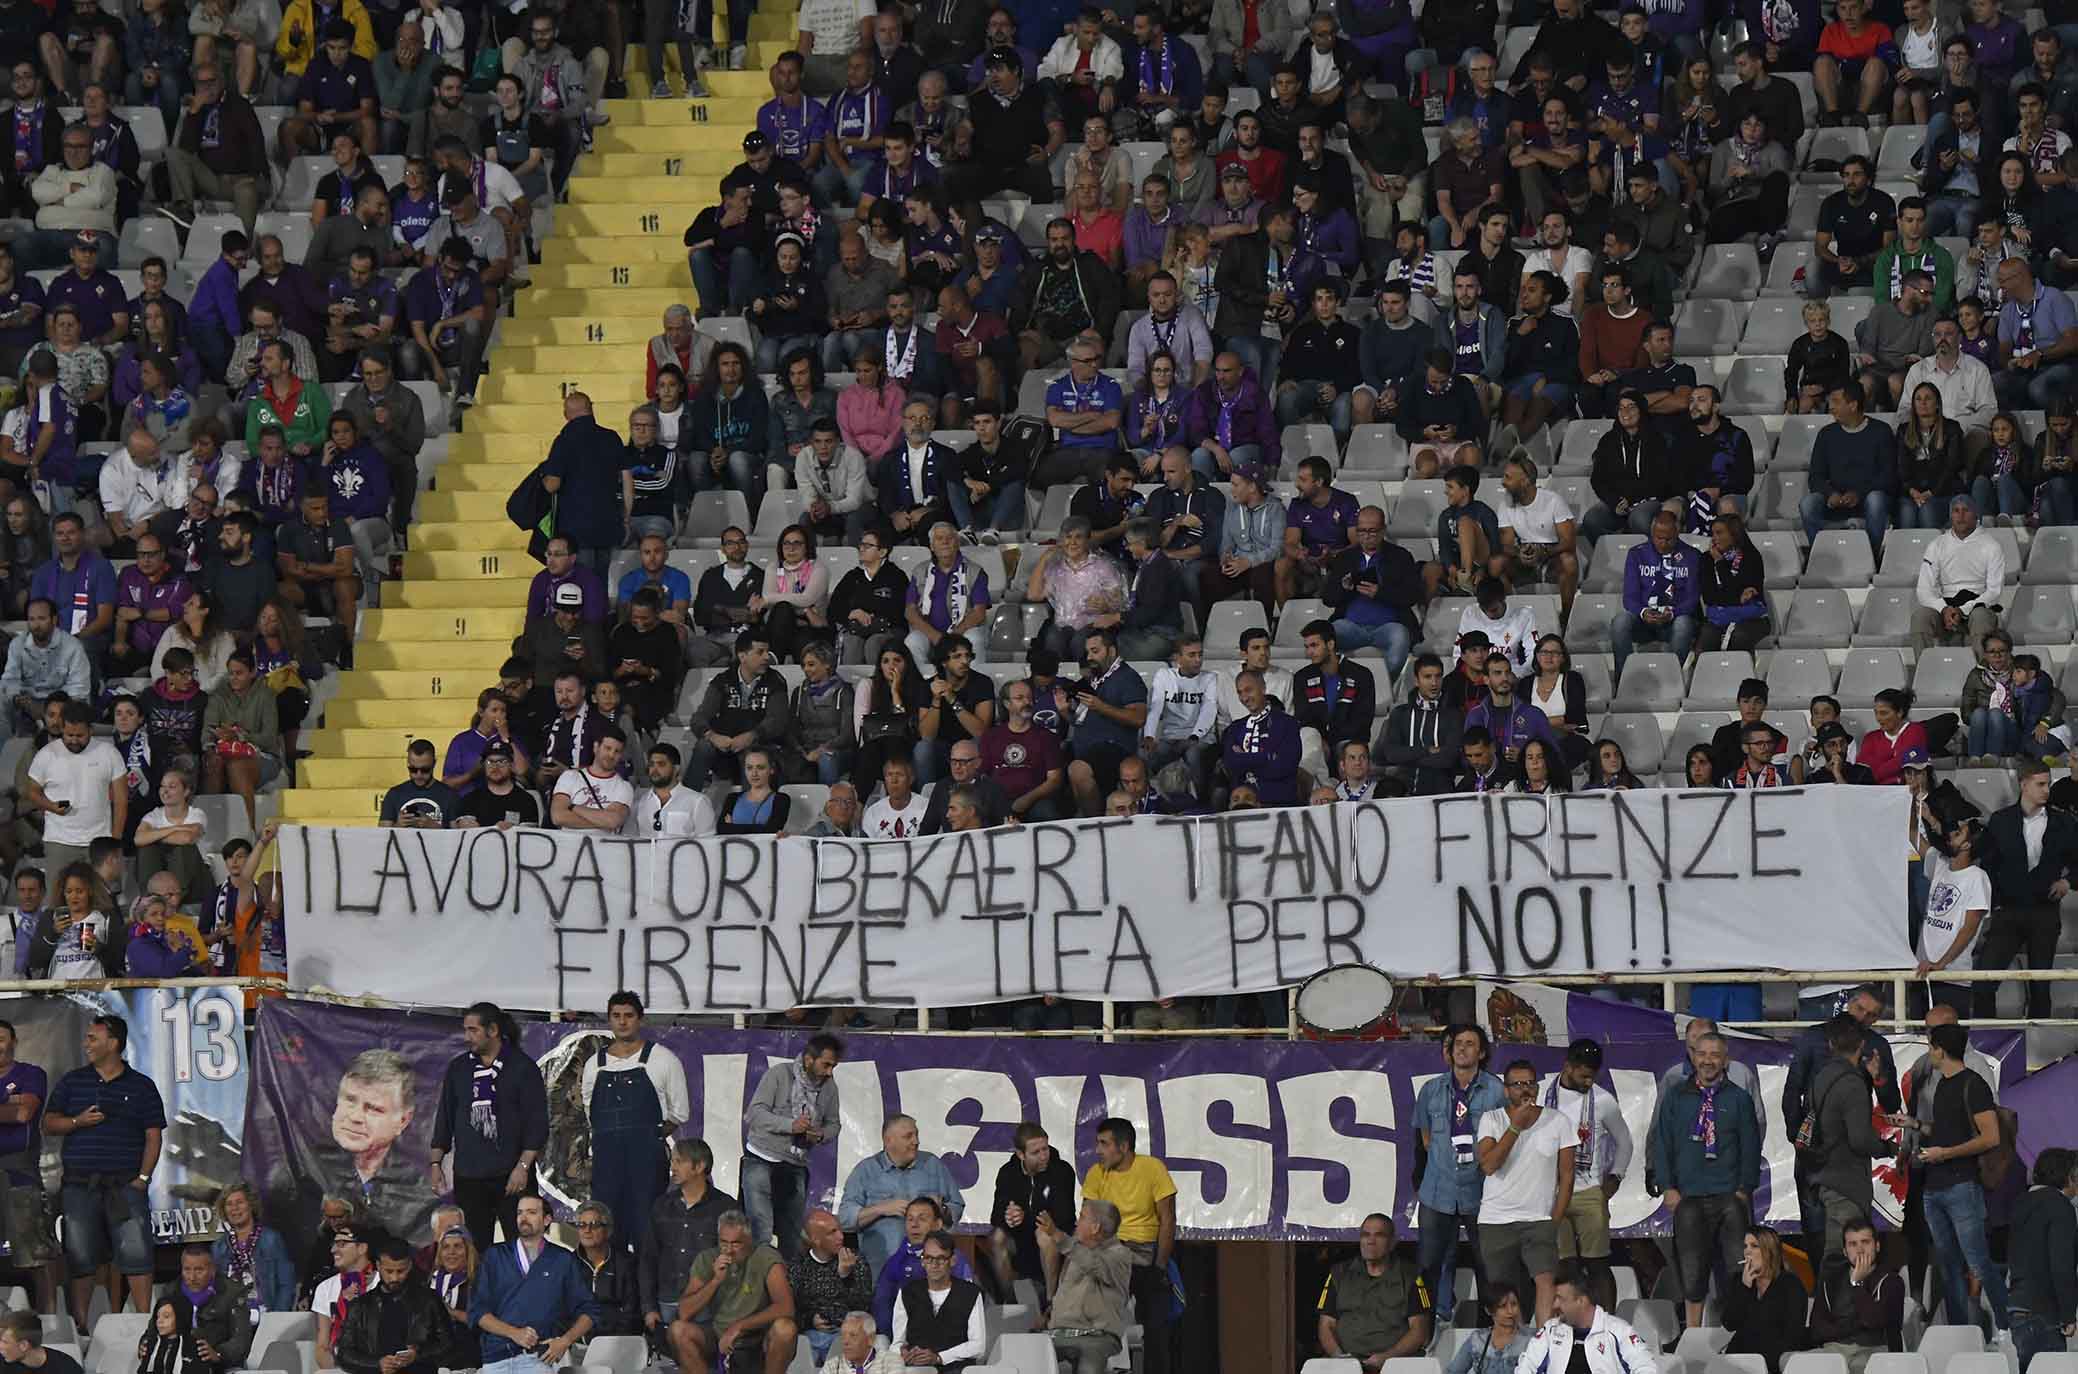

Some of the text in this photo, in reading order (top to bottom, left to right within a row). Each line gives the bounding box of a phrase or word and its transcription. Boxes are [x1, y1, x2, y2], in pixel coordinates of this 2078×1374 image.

[690, 104, 708, 121] 18
[666, 159, 681, 175] 17
[640, 215, 660, 232] 16
[612, 267, 629, 284] 15
[586, 323, 604, 341] 14
[480, 556, 499, 574] 10
[456, 617, 466, 635] 9
[432, 677, 442, 694] 8
[808, 819, 1133, 919] BEKAERT
[1156, 802, 1391, 901] TIFANO
[1432, 789, 1805, 882] FIRENZE
[554, 920, 916, 1009] FIRENZE
[961, 905, 1162, 998] TIFA
[1227, 894, 1365, 988] PER
[161, 996, 240, 1083] 13
[151, 1207, 231, 1237] EMP
